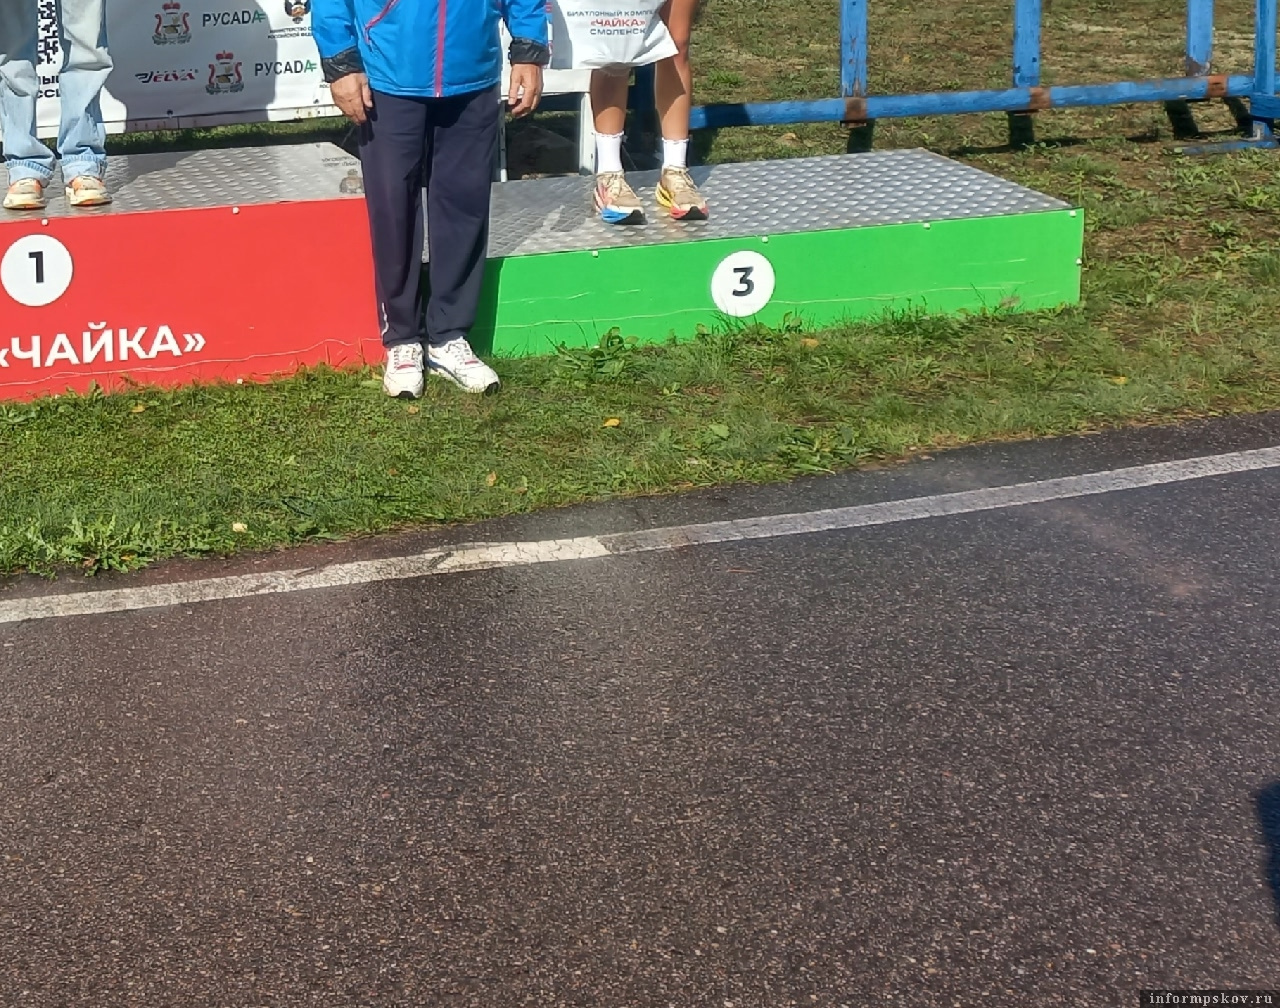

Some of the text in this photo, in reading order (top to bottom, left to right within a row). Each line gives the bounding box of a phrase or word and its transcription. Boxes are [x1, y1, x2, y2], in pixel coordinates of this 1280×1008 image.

[590, 18, 646, 28] «ЧАЙКА»
[590, 28, 647, 36] СМОЛЕНСК
[28, 250, 45, 284] 1
[732, 266, 755, 297] 3
